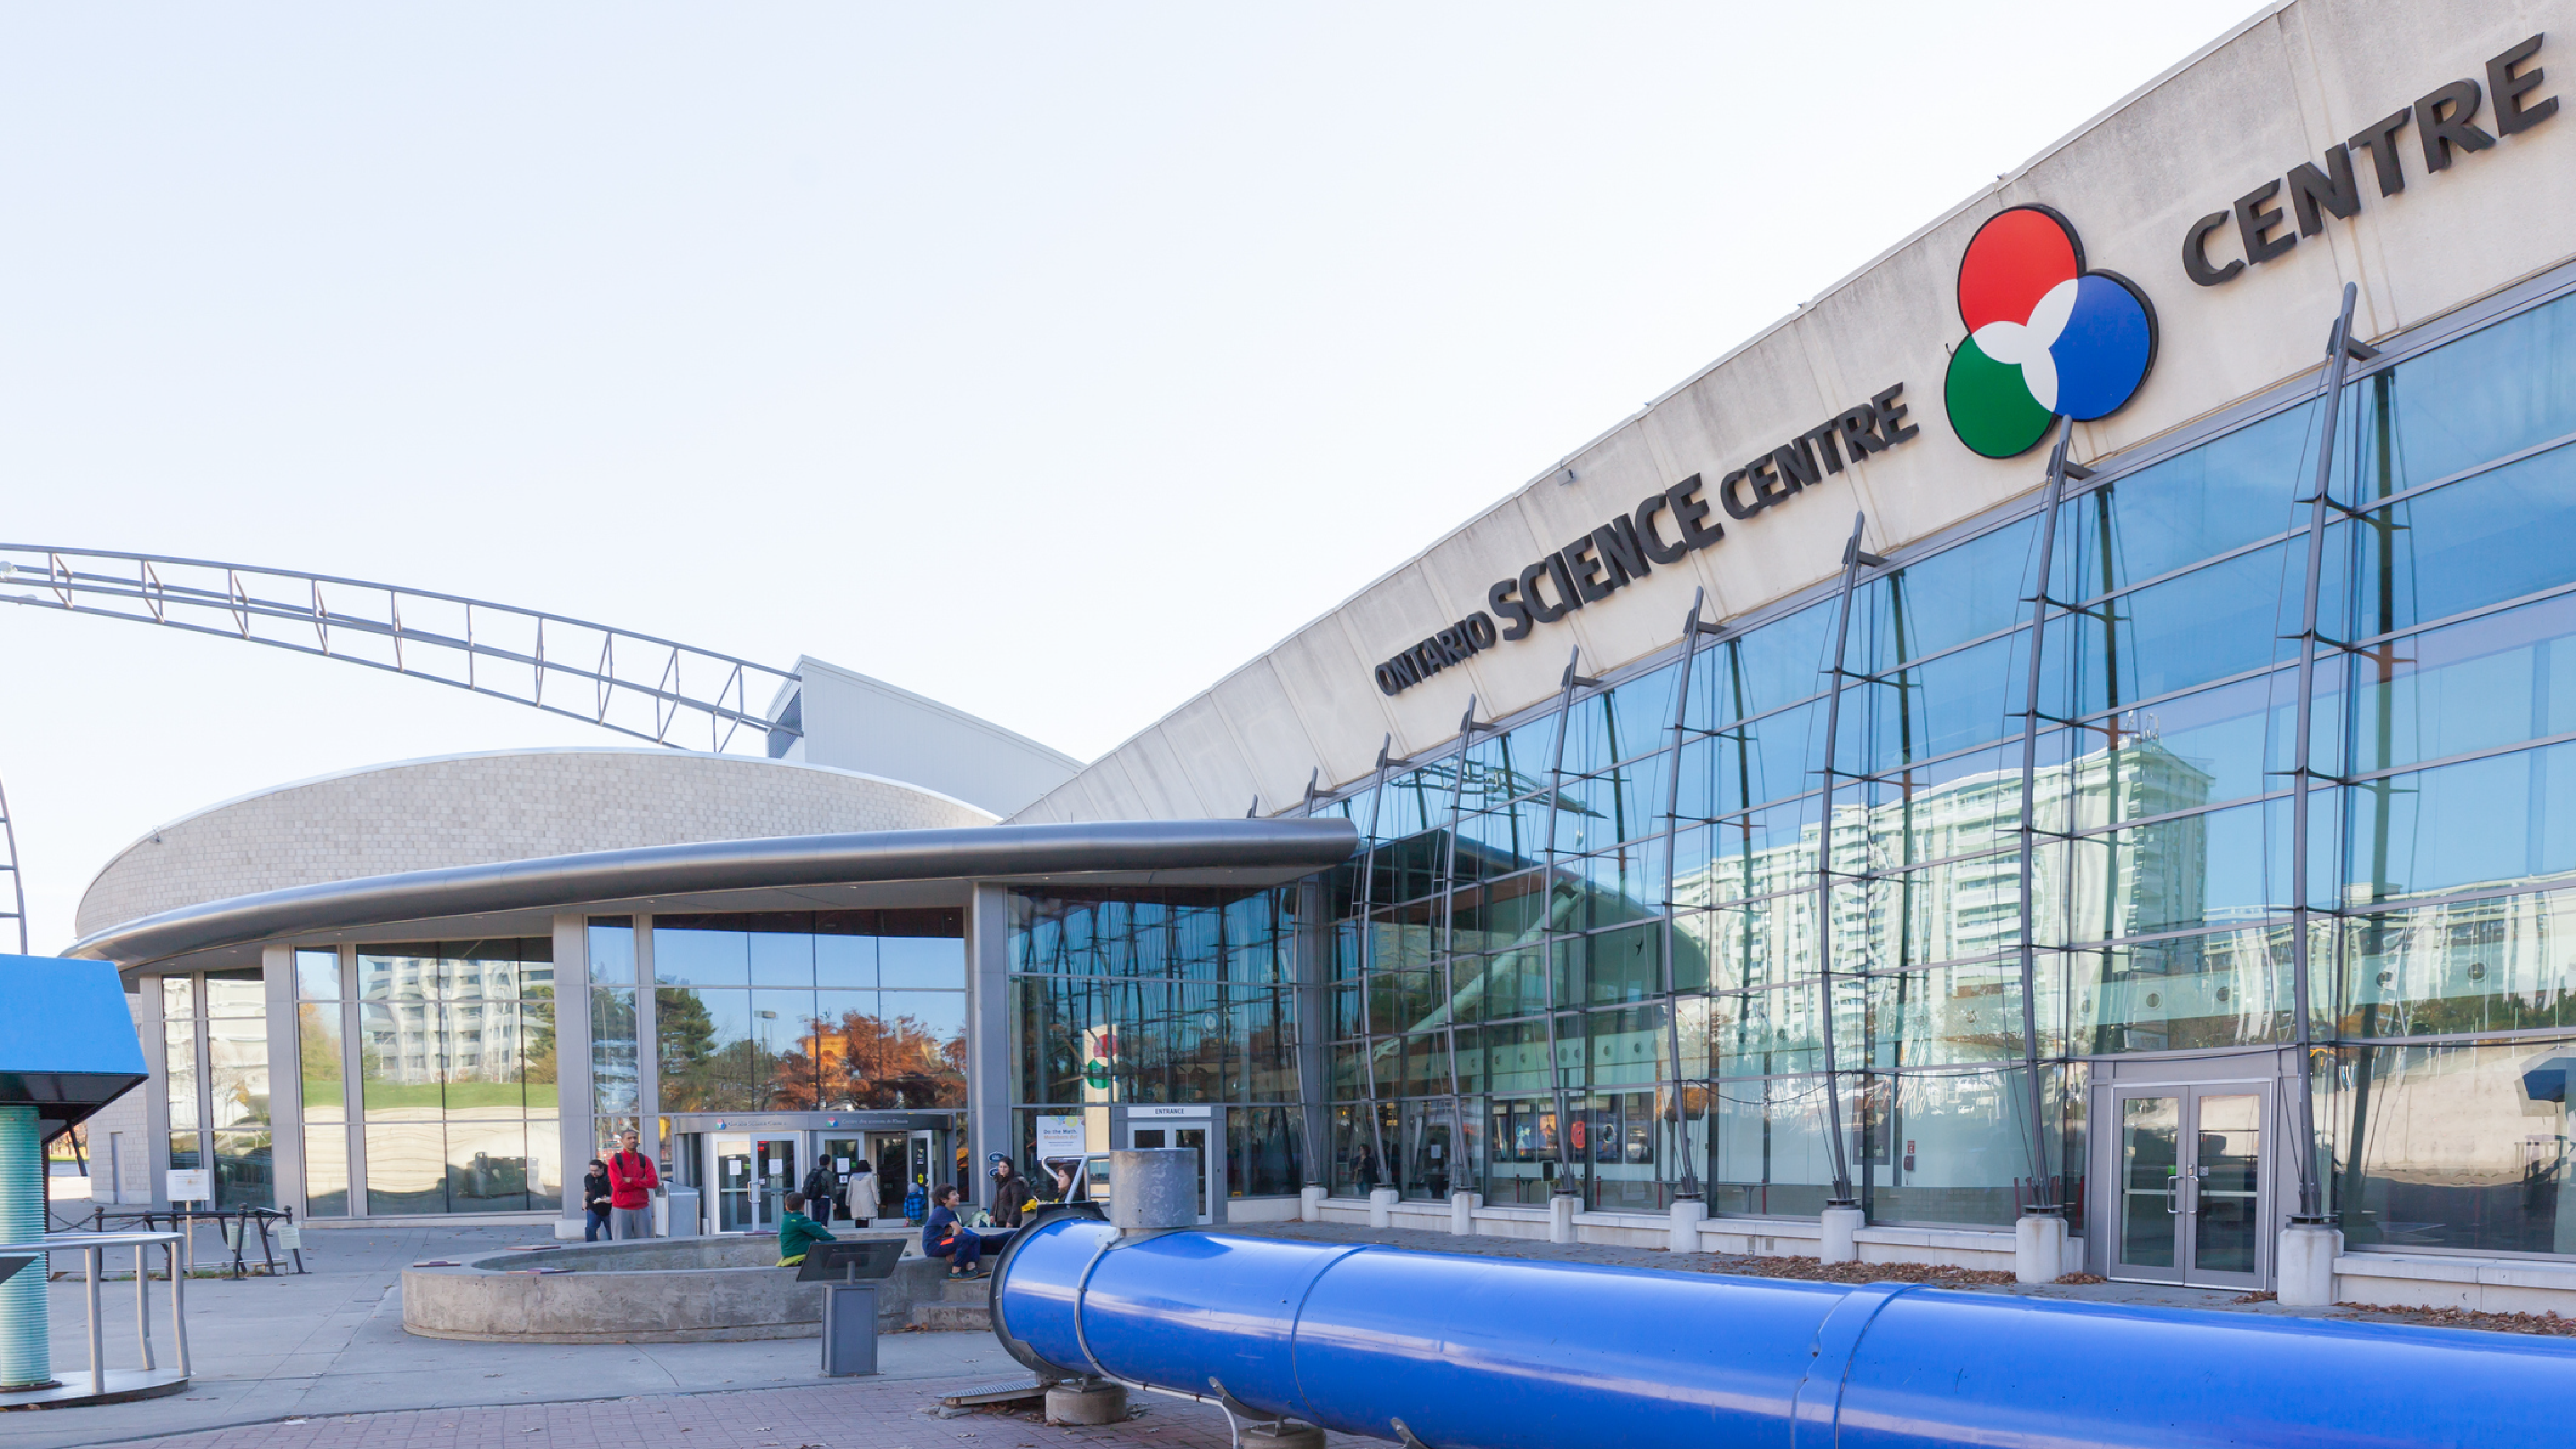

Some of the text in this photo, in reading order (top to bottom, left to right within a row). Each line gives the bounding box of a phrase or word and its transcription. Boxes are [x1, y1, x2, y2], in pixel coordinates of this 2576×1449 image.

[2182, 31, 2559, 286] CENTRE
[1374, 381, 1919, 696] ONTARIO SCIENCE CENTRE
